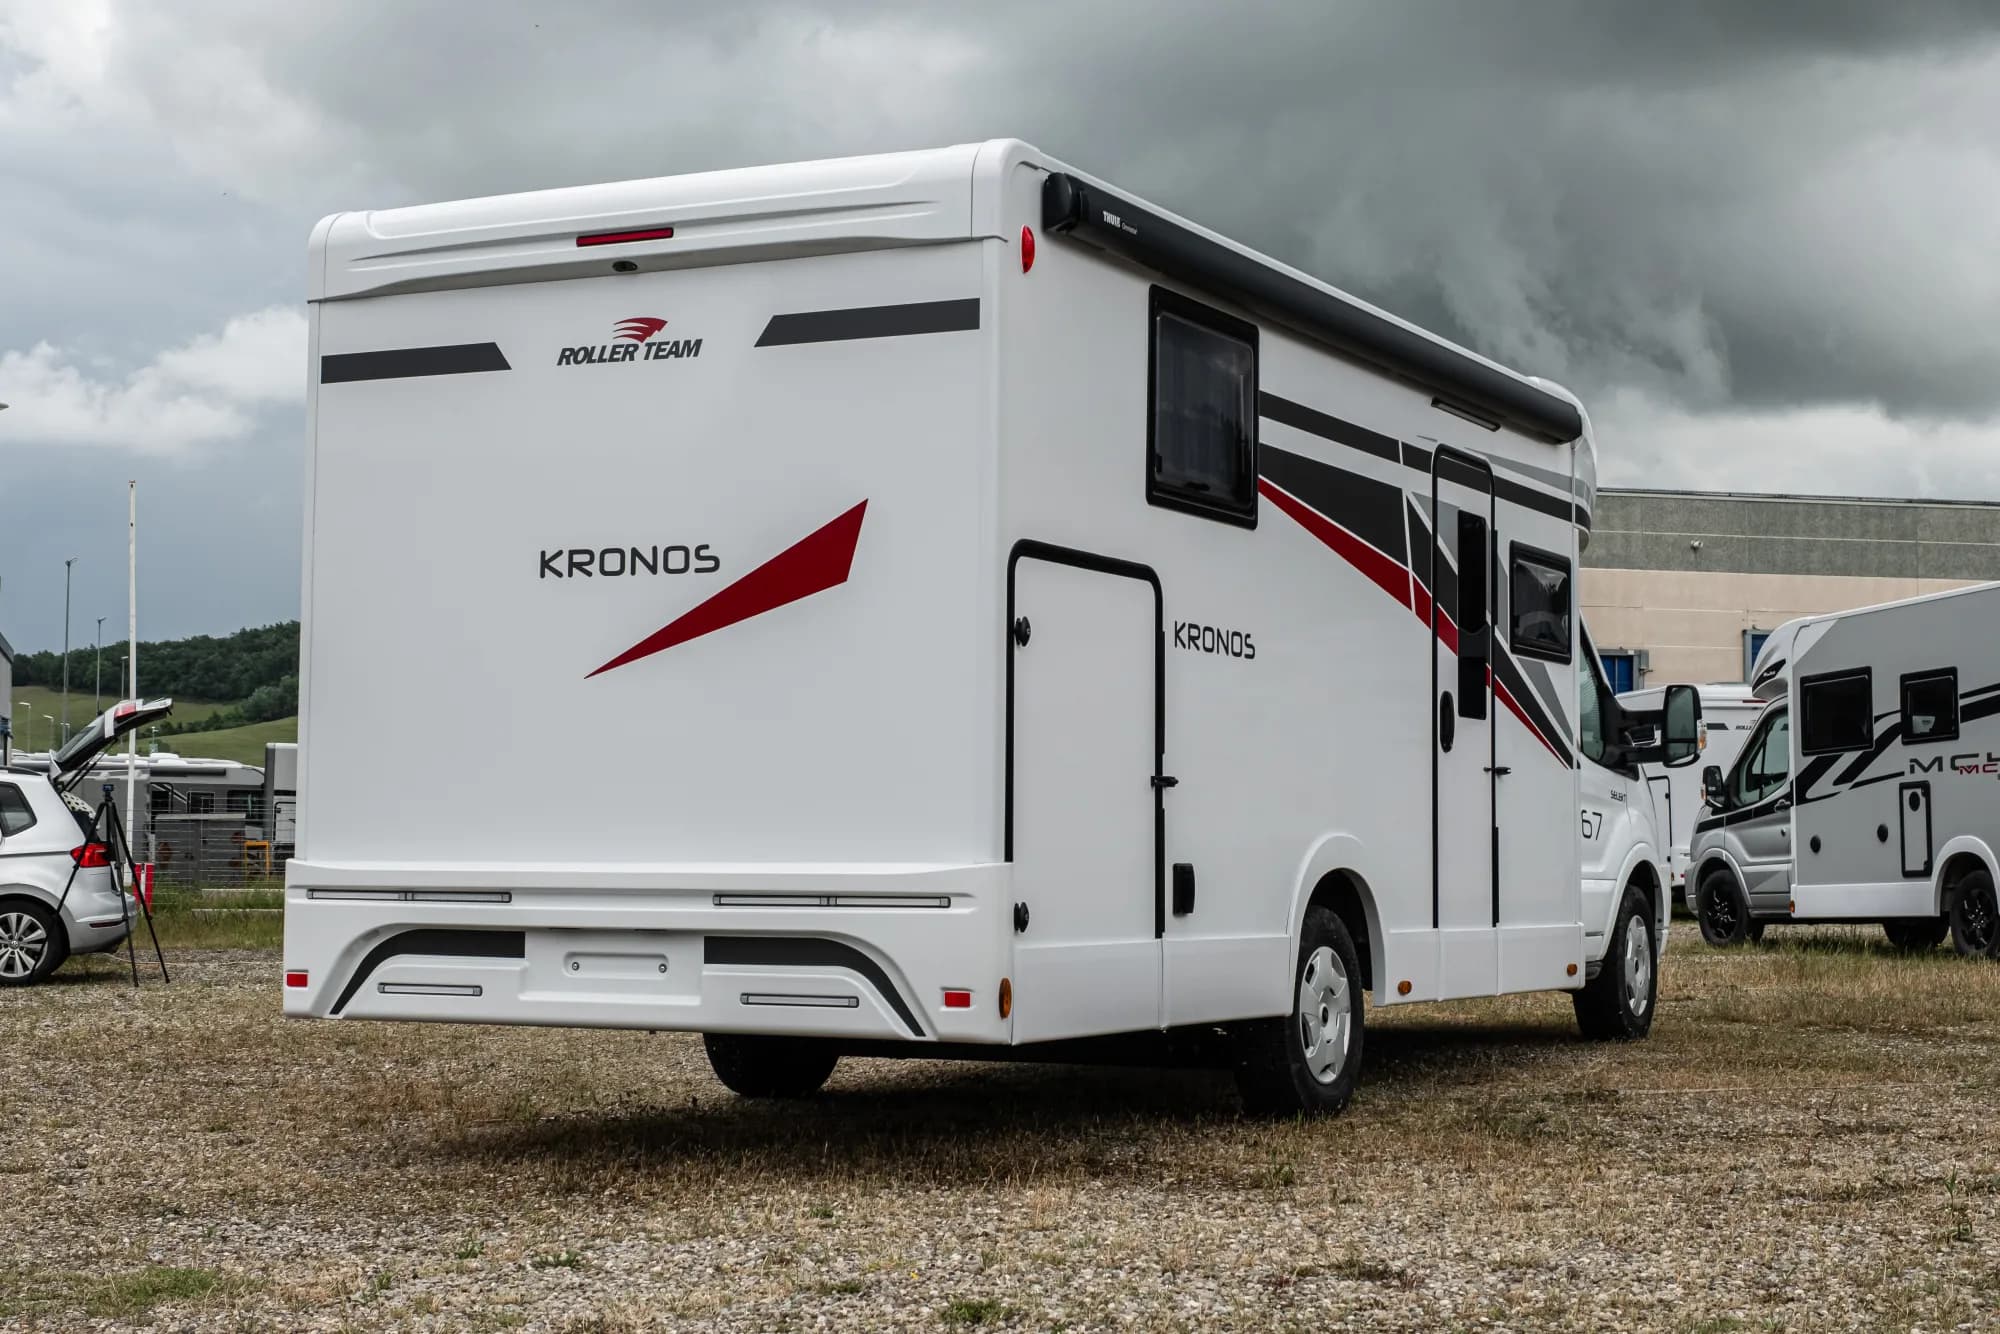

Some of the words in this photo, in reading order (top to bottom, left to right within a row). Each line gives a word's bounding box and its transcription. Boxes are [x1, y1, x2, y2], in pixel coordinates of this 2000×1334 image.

[1103, 210, 1121, 228] THULE
[557, 343, 639, 366] ROLLER
[643, 338, 703, 361] TEAM
[540, 544, 720, 579] KRONOS
[1174, 620, 1256, 660] KRONOS
[1580, 809, 1603, 841] 67
